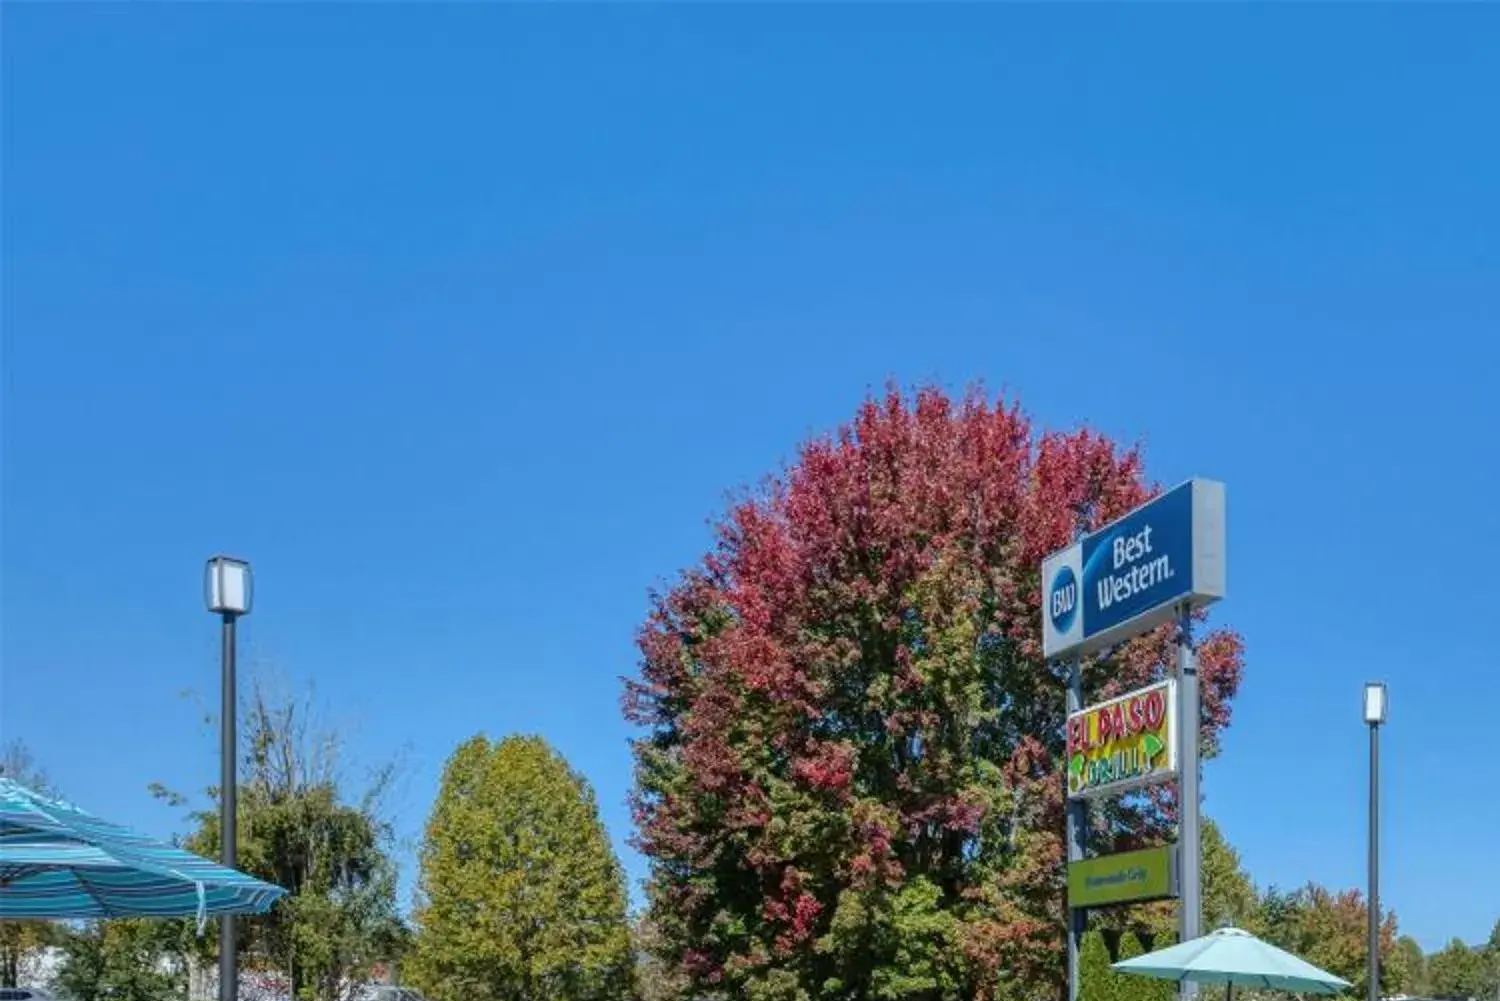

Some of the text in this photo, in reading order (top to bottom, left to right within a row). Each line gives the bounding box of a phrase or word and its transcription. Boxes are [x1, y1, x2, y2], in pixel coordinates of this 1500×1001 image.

[1113, 524, 1152, 569] Best
[1067, 690, 1165, 757] EL PASO
